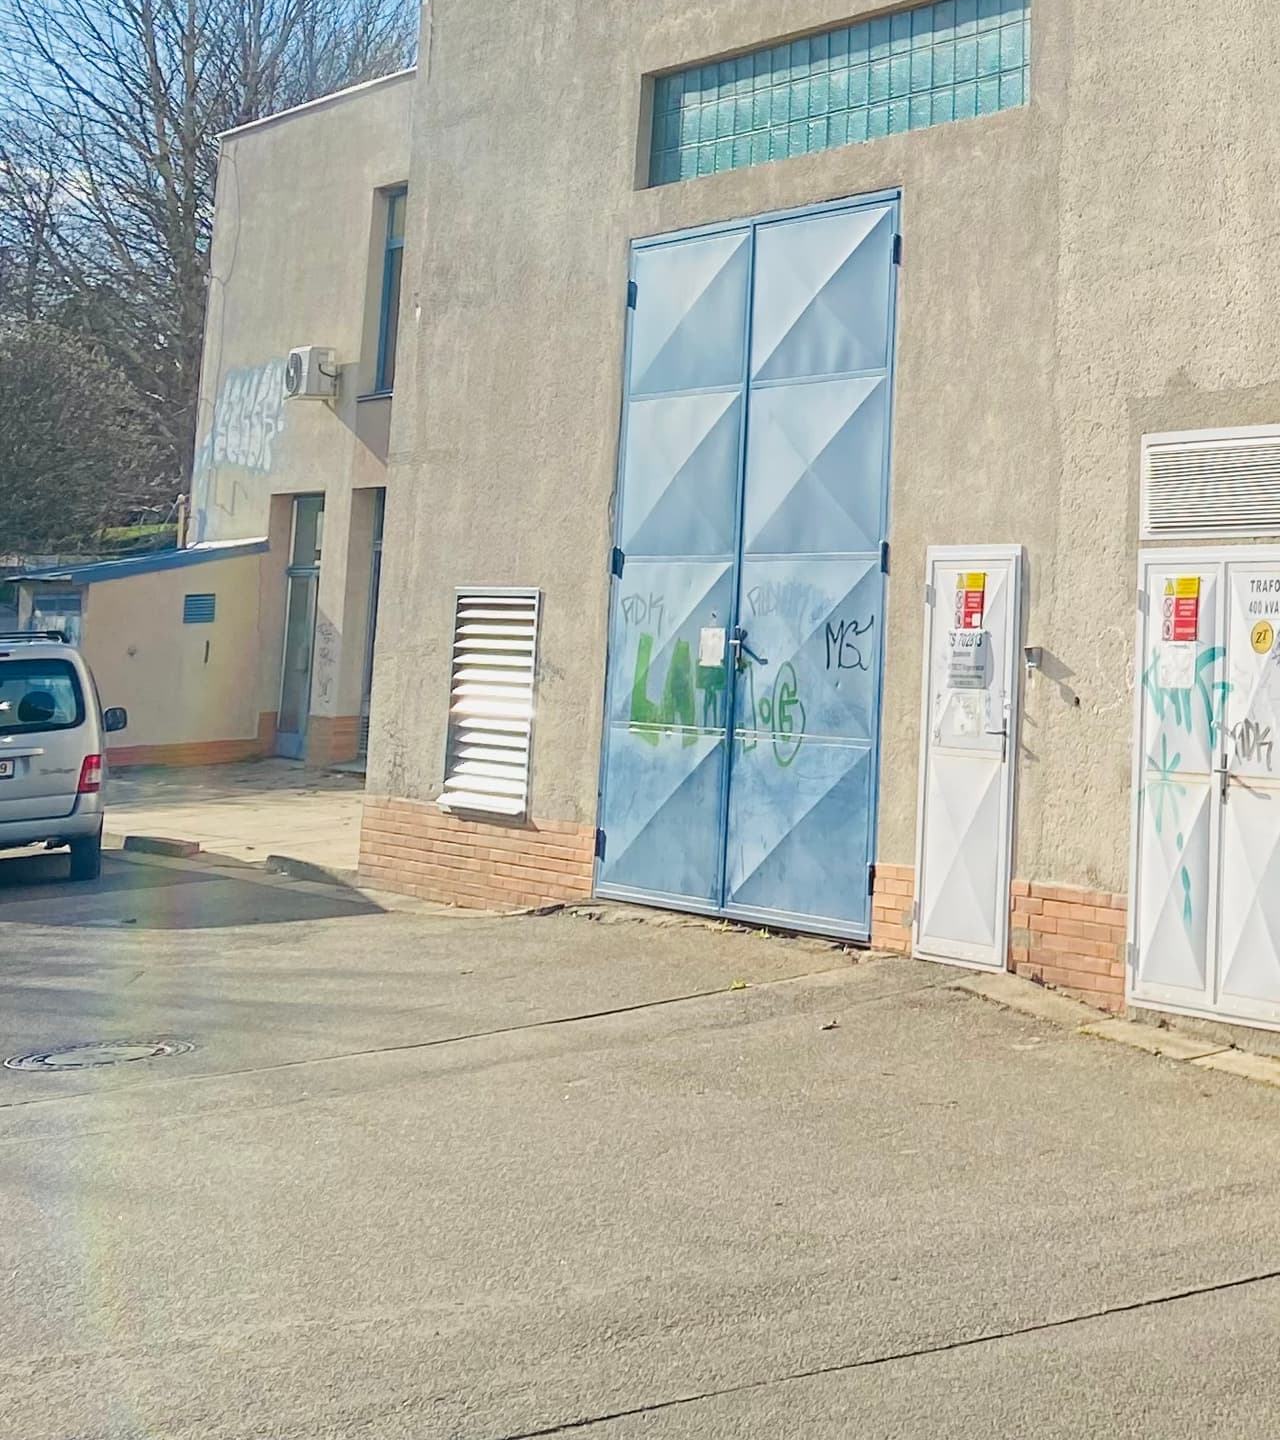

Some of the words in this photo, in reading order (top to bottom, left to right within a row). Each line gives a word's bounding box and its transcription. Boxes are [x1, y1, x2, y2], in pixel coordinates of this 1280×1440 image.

[1250, 579, 1280, 593] TRAFO
[1249, 601, 1263, 614] 400
[1264, 601, 1279, 614] kVA
